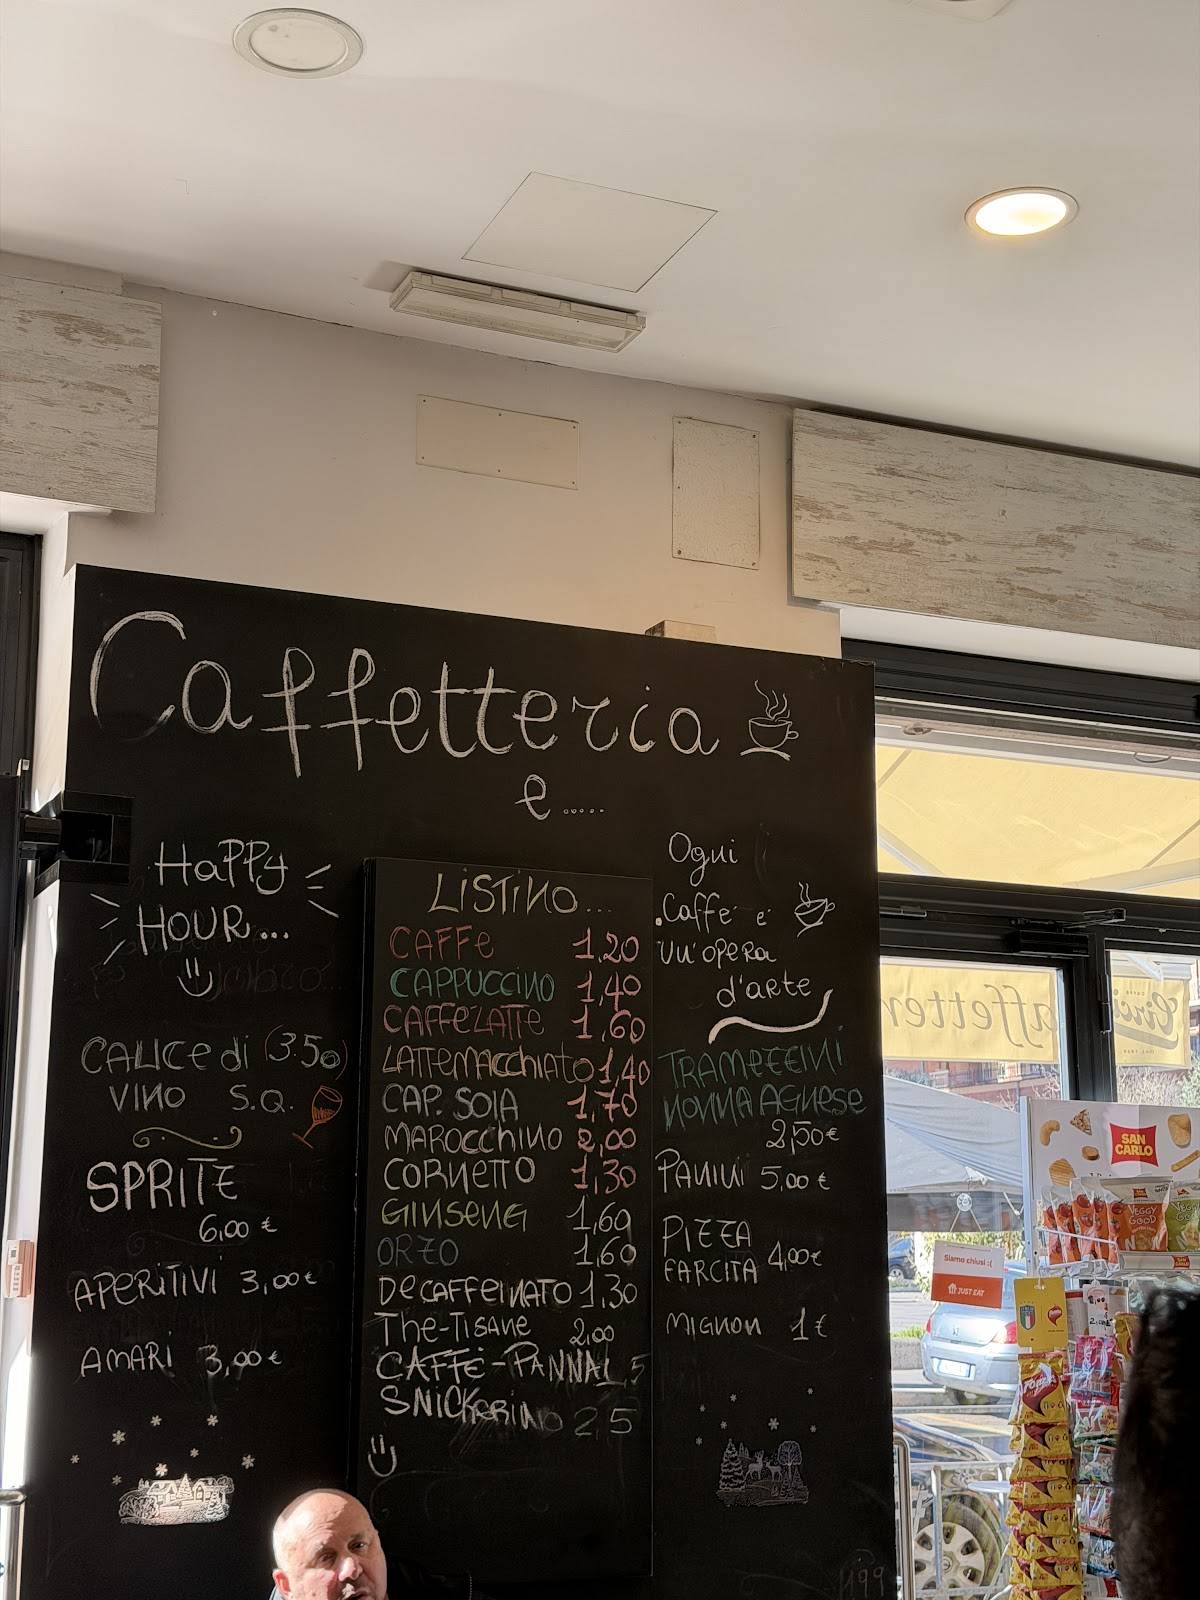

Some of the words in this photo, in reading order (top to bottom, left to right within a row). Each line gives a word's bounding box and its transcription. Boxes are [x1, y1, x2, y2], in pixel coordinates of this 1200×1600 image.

[90, 609, 720, 779] Caffetteria
[572, 927, 640, 963] 1,20
[575, 970, 642, 1012] 1,40
[571, 1002, 646, 1044] 1,60
[220, 1034, 250, 1073] di
[598, 1046, 651, 1100] 1,40
[109, 1081, 187, 1113] VINO
[228, 1083, 295, 1113] S.Q.
[382, 1082, 444, 1116] CAP.
[453, 1086, 519, 1122] SOIA
[567, 1083, 638, 1122] 1,70
[663, 1085, 753, 1132] NONNA
[577, 1127, 637, 1158] 2,00
[1115, 1144, 1154, 1157] CARLO
[1121, 1133, 1146, 1145] SAN
[571, 1153, 638, 1195] 1,30
[376, 1232, 459, 1267] ORZO
[574, 1233, 637, 1267] 1,60
[943, 1253, 966, 1264] Siamo
[579, 1269, 639, 1309] 1,30
[664, 1257, 759, 1287] FARCITA
[957, 1286, 972, 1296] JUST
[972, 1287, 985, 1297] EAT
[568, 1316, 616, 1346] 2,00
